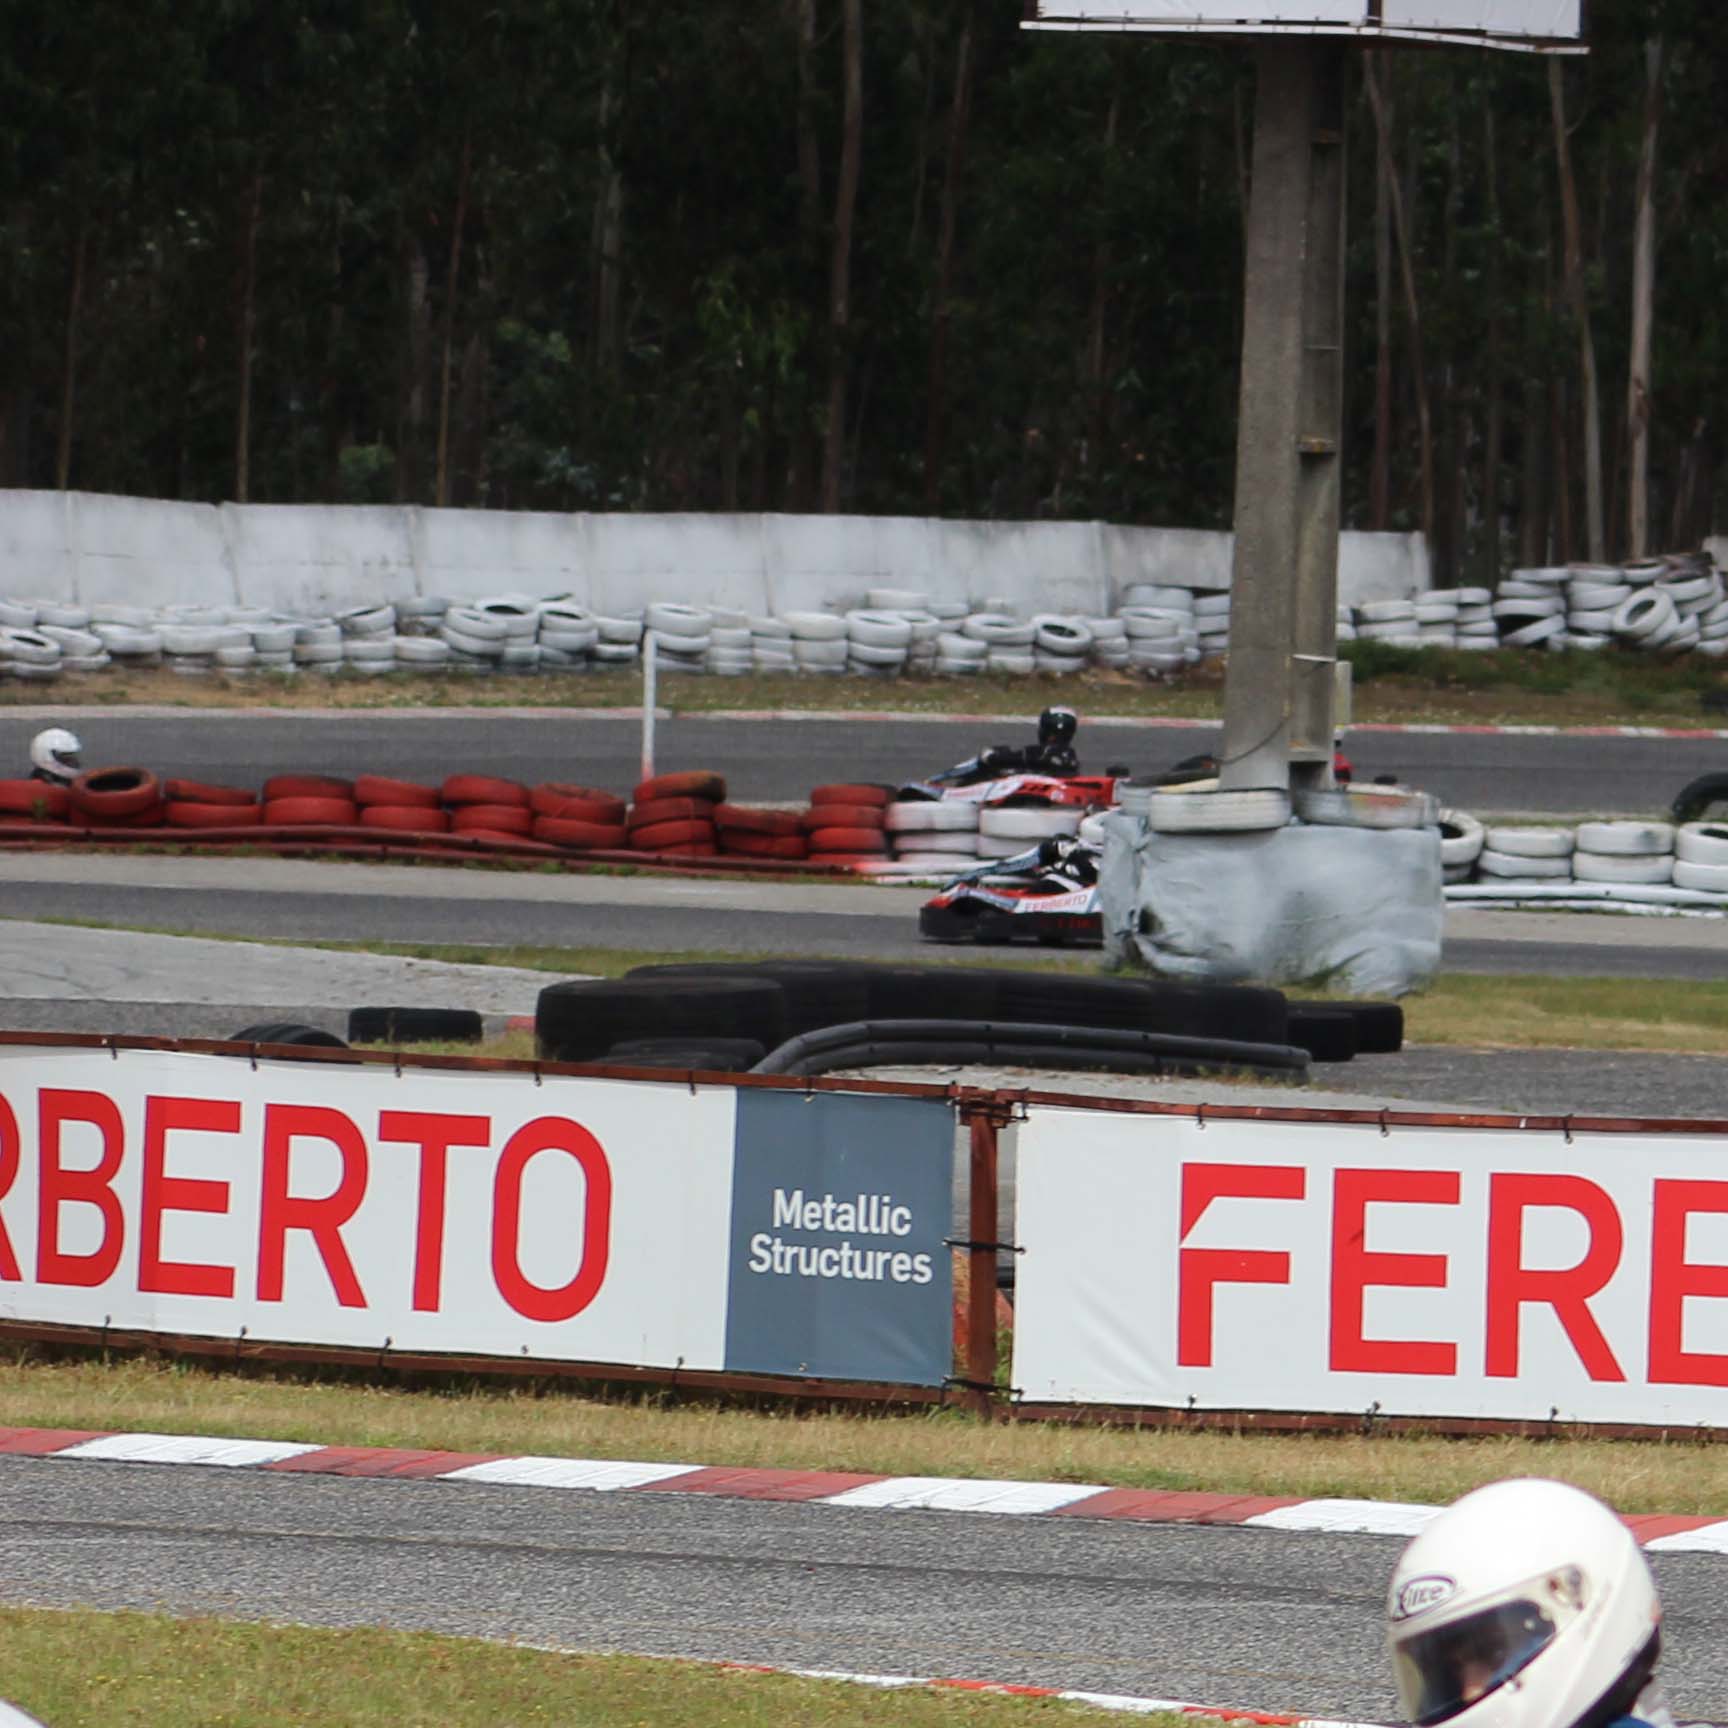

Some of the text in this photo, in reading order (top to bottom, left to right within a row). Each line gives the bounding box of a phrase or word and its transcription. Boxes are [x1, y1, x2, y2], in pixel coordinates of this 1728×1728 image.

[0, 1088, 613, 1323] BERTO
[772, 1188, 912, 1238] Metallic
[748, 1234, 932, 1284] Structures
